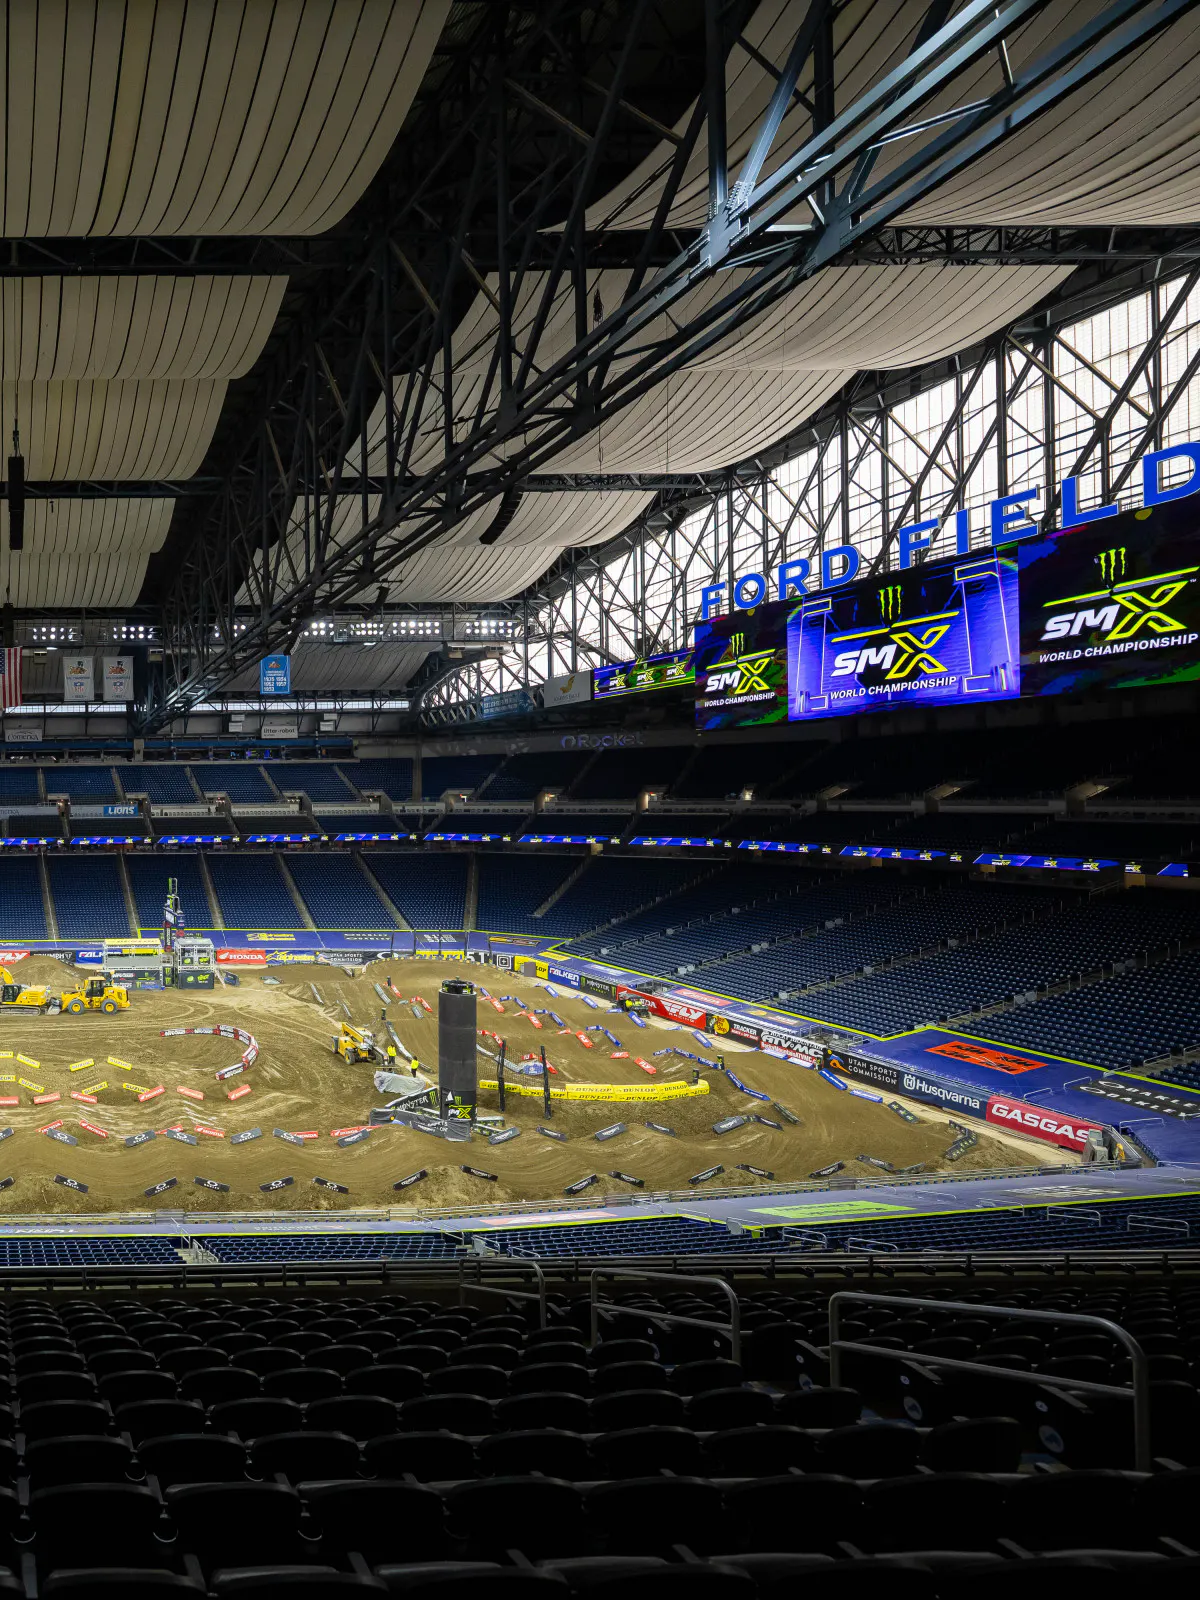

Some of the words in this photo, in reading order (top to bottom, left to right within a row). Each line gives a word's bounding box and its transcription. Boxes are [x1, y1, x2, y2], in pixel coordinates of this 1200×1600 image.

[702, 545, 861, 620] FORD
[899, 442, 1200, 570] FIELD
[1041, 580, 1189, 642] SMX
[831, 625, 951, 680] SMX
[1039, 648, 1083, 664] WORLD
[1084, 633, 1199, 658] CHAMPIONSHIP
[705, 657, 770, 693] SMX
[830, 687, 870, 701] WORLD
[870, 676, 957, 697] CHAMPIONSHIP
[704, 698, 725, 708] WORLD
[725, 691, 775, 706] CHAMPIONSHIP
[549, 967, 580, 982] FALKEN
[668, 1003, 704, 1020] FLY
[668, 1012, 696, 1023] RACING
[733, 1024, 757, 1036] TRACKER
[847, 1065, 898, 1085] COMMISSION
[848, 1058, 866, 1070] UTAH
[867, 1062, 898, 1078] SPORTS
[663, 1084, 688, 1092] DUNLOP
[915, 1079, 981, 1110] Husqvarna
[87, 1125, 107, 1138] HONDA
[991, 1103, 1089, 1143] GASGAS
